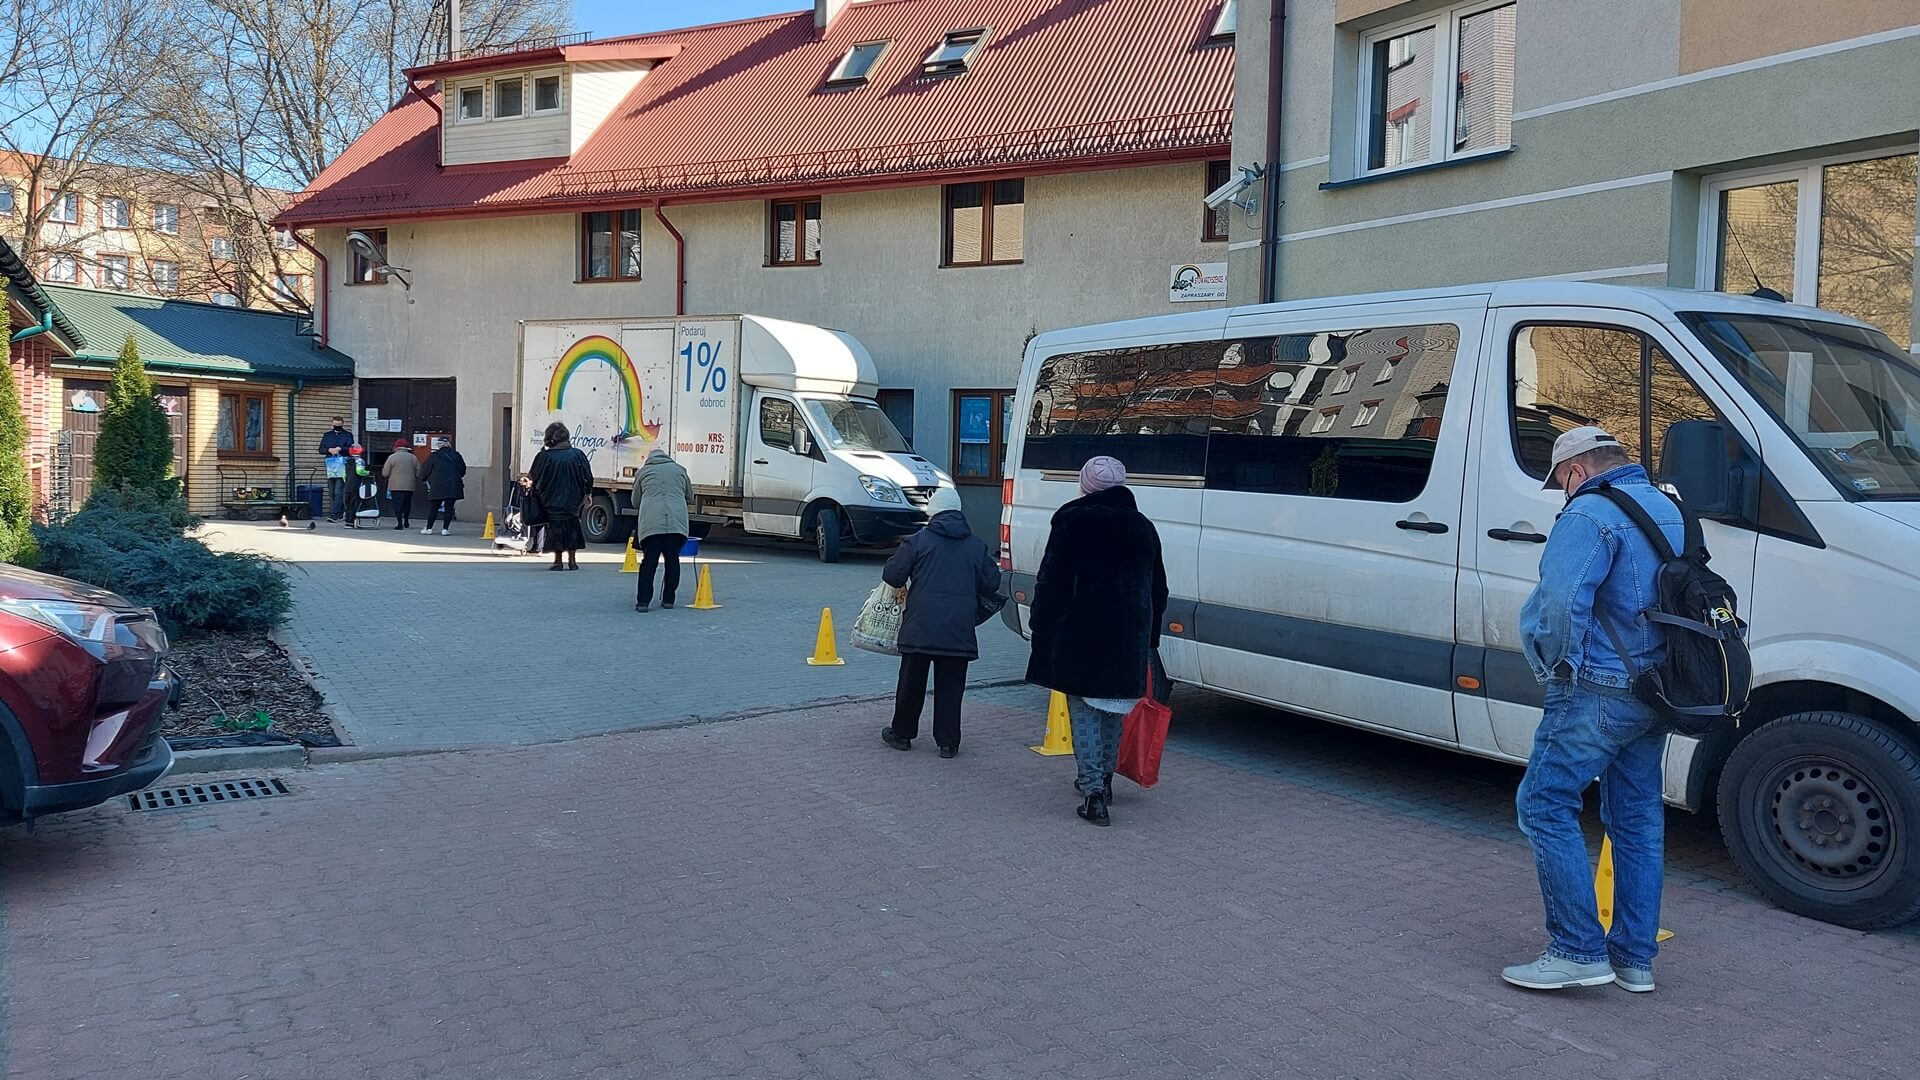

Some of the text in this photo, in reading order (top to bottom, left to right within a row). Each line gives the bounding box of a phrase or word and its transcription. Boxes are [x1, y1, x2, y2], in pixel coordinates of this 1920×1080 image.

[680, 325, 707, 338] Podaruj
[680, 340, 727, 393] 1%
[699, 397, 726, 408] dobroci
[569, 423, 608, 461] droga
[708, 432, 725, 443] KRS:
[676, 442, 724, 454] 0000 087 872
